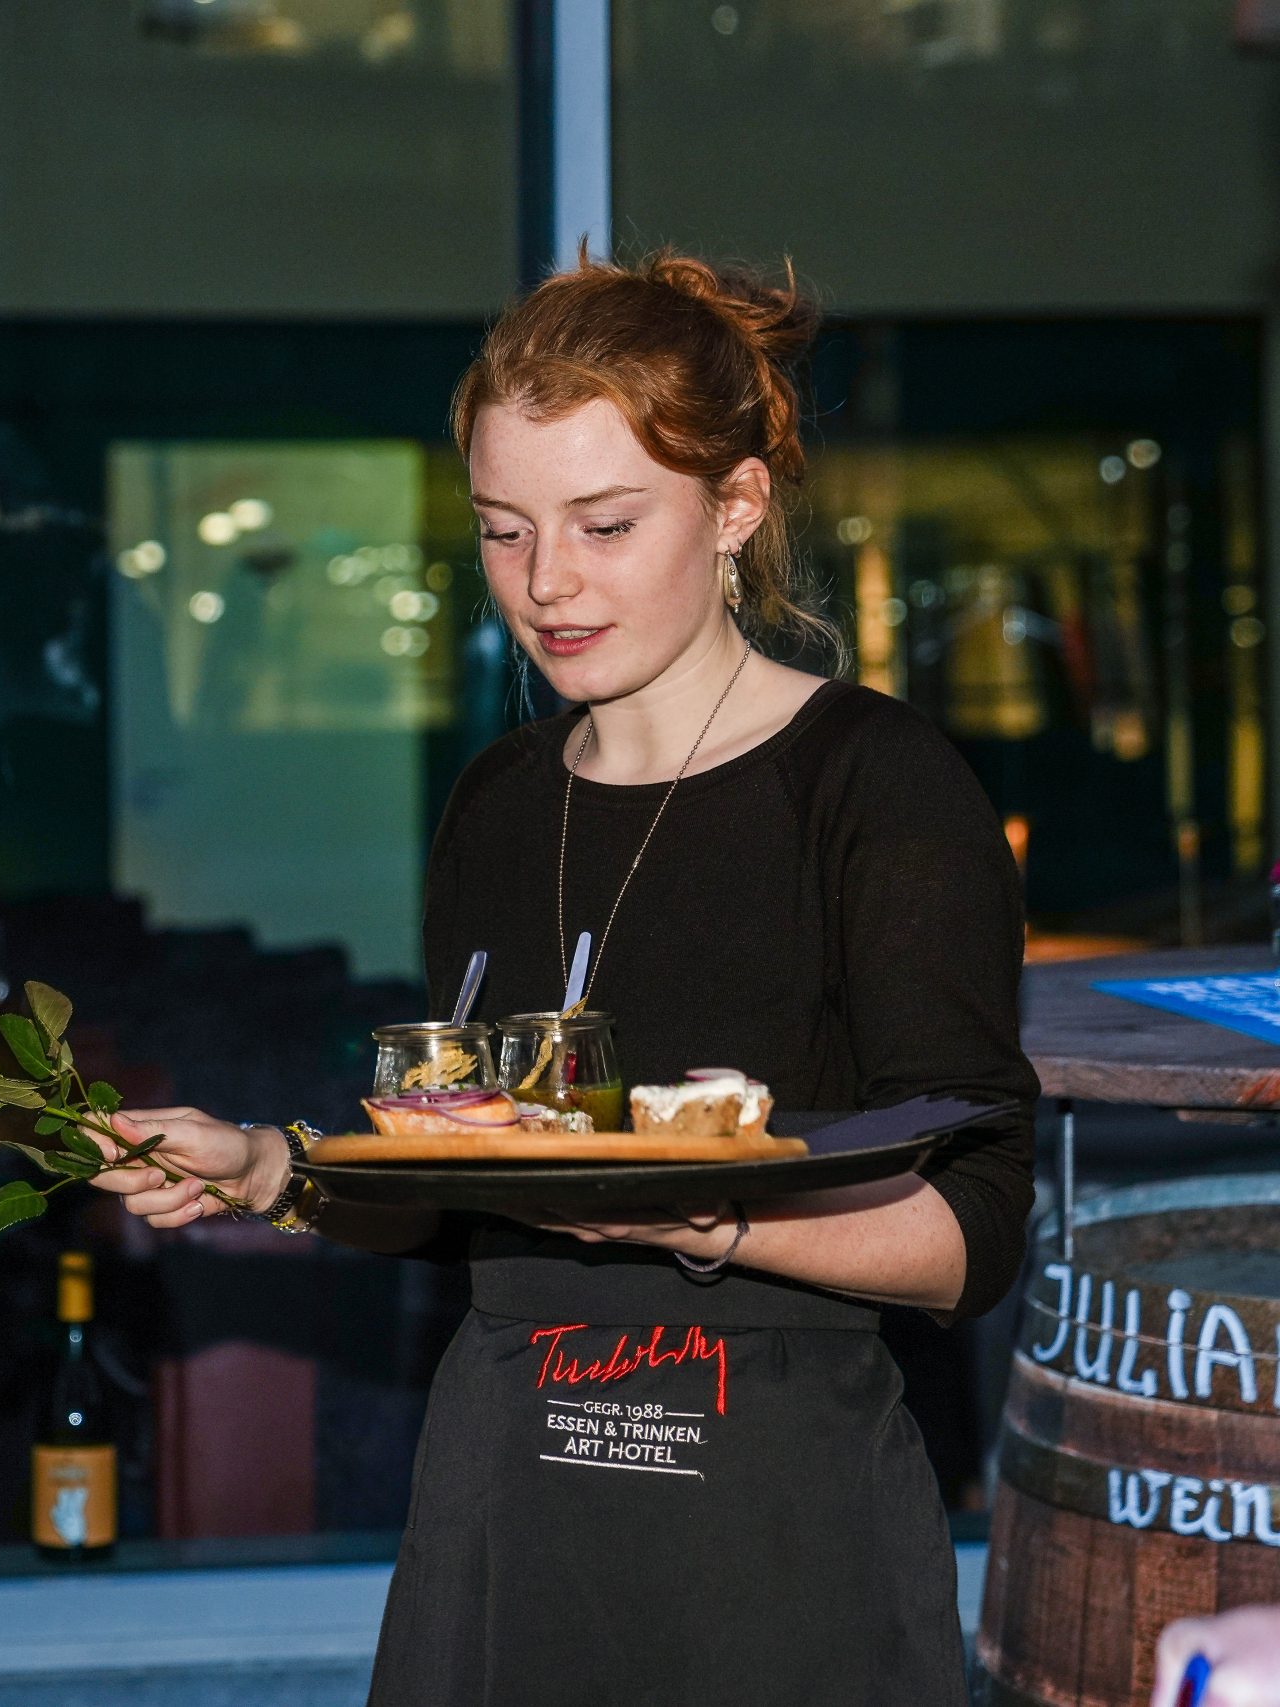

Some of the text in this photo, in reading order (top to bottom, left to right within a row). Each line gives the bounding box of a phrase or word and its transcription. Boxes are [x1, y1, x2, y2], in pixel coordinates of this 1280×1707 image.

[582, 1400, 664, 1422] GEGR. 1988
[546, 1413, 702, 1444] ESSEN & TRINKEN
[563, 1435, 677, 1465] ART HOTEL
